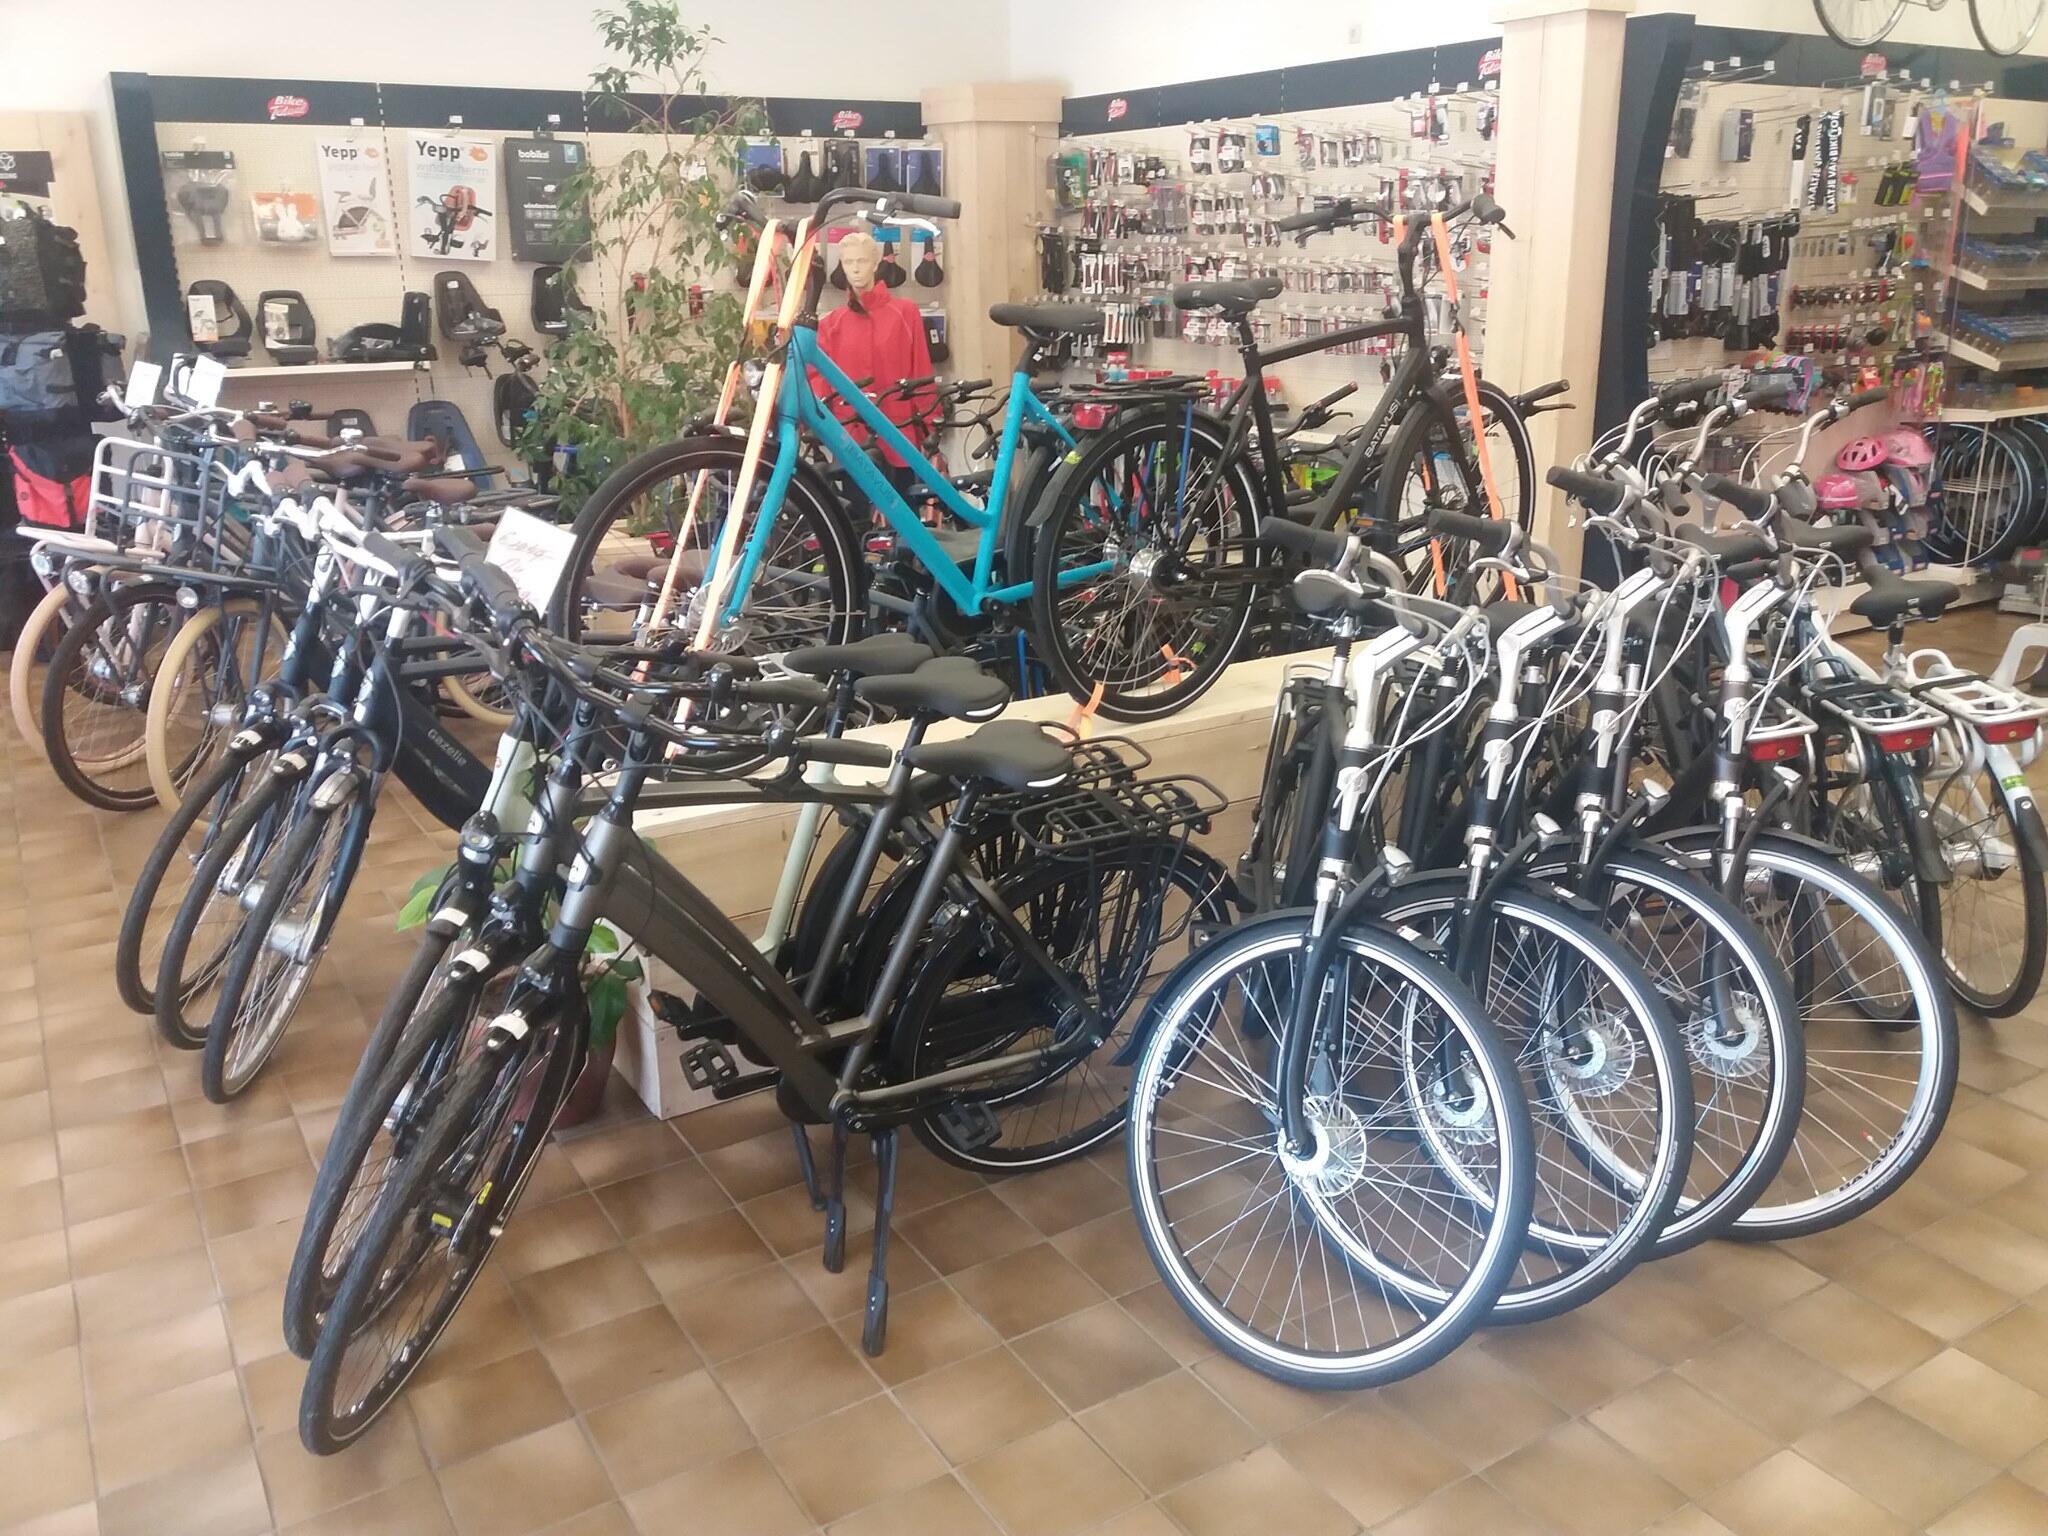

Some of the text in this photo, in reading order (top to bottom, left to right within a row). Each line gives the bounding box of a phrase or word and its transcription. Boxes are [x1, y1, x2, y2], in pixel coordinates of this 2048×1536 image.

[274, 95, 304, 105] Bike
[321, 145, 358, 160] Yepp
[416, 140, 460, 162] Yepp
[1364, 401, 1399, 458] BATAVUS
[427, 728, 467, 767] Gazelle
[1839, 1130, 1905, 1192] BATAVUS
